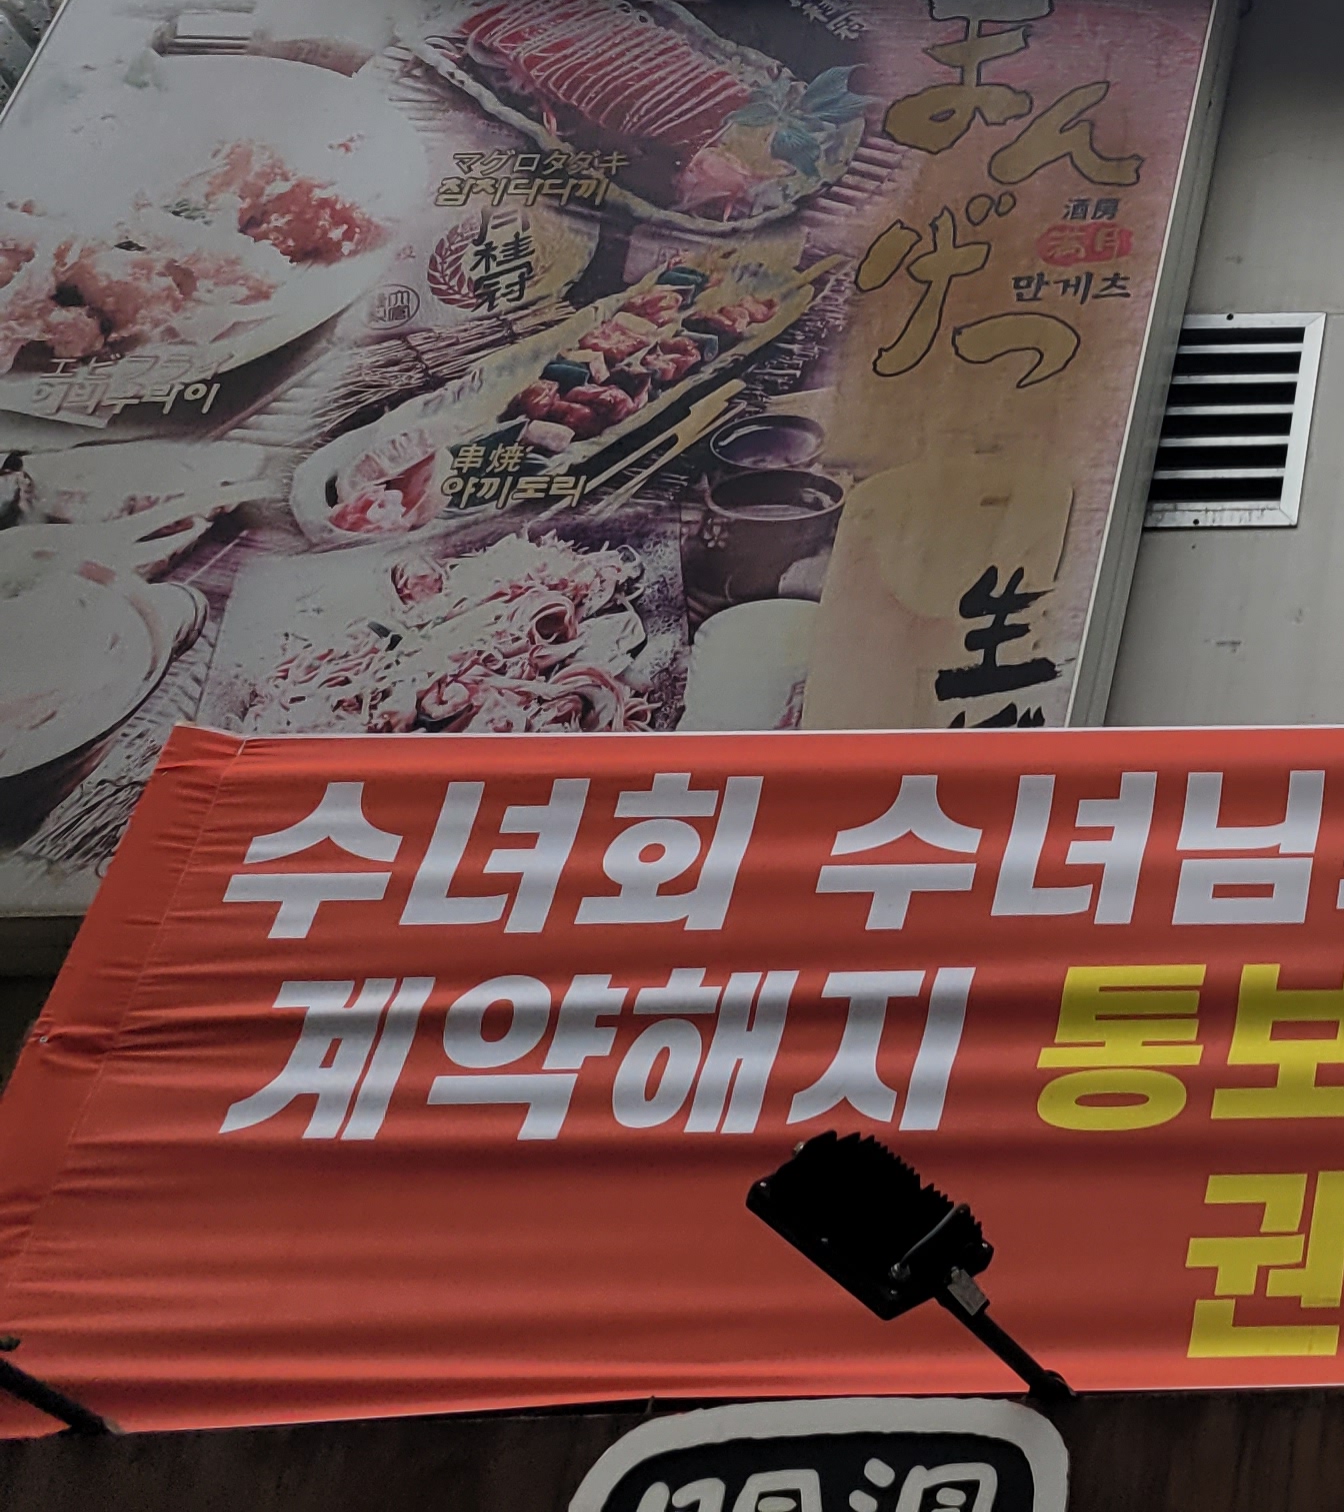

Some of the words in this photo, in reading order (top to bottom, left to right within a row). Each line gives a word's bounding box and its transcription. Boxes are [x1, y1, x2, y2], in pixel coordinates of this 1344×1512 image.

[1012, 271, 1132, 305] 만게츠
[441, 475, 588, 509] 야끼도리
[934, 564, 1066, 727] 生
[222, 771, 764, 940] 수녀회
[219, 966, 976, 1141] 계약해지
